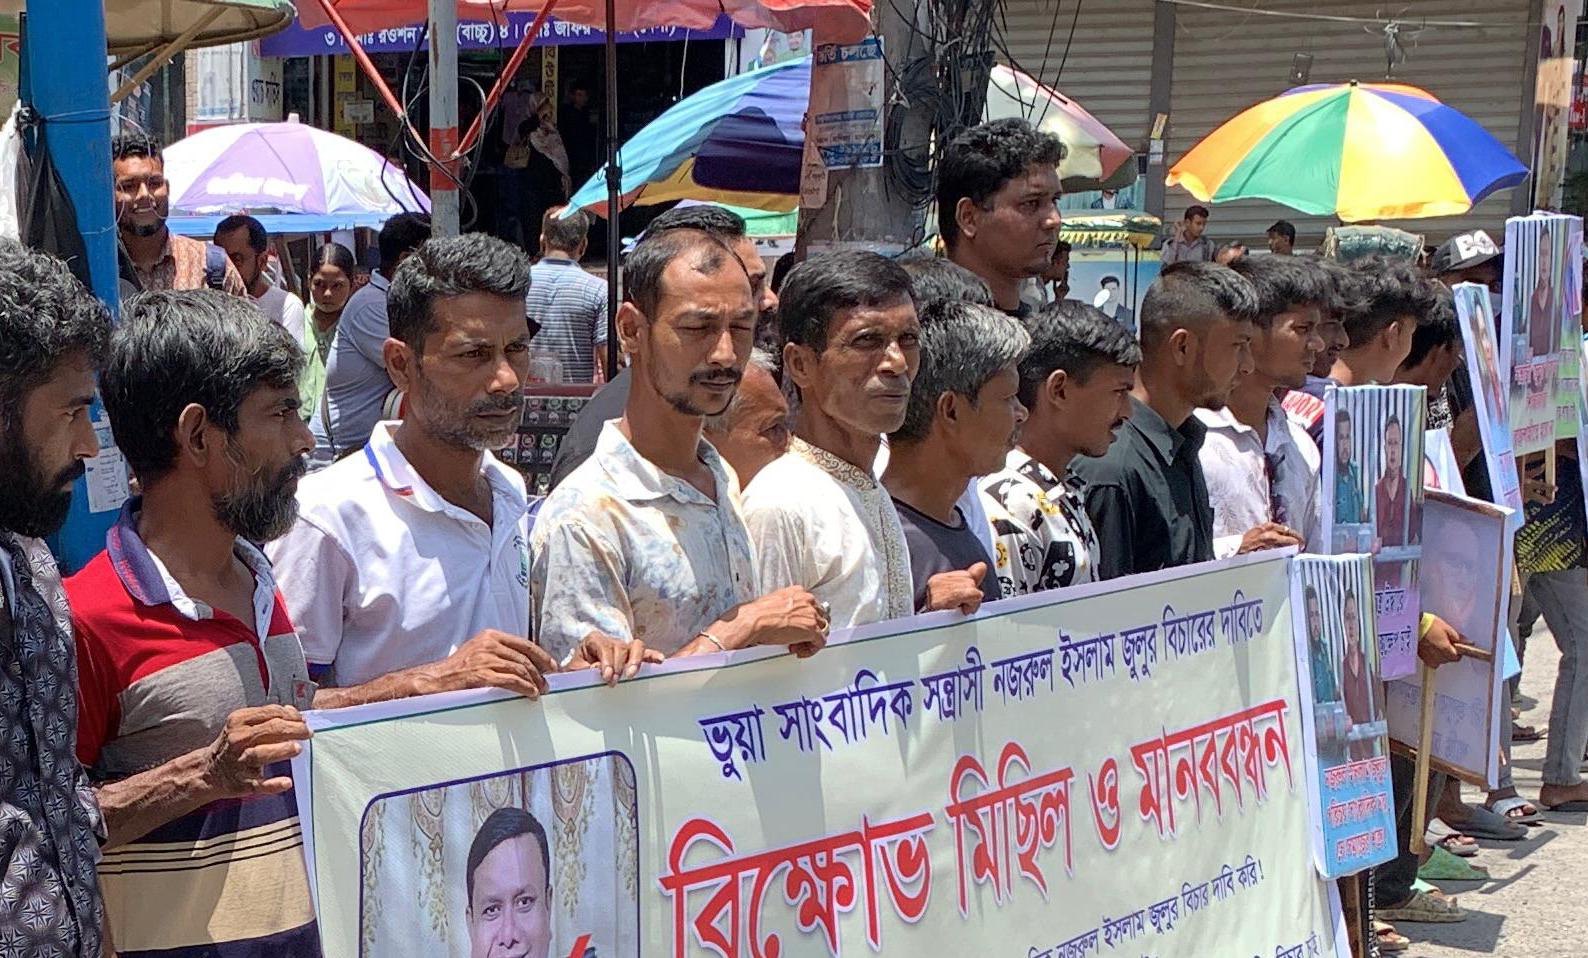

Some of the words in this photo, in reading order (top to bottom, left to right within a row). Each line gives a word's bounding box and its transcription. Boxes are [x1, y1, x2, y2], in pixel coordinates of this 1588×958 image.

[701, 710, 766, 781] ভুয়া
[775, 670, 913, 751] সাংবাদিক
[923, 648, 985, 722] সন্ত্রাসী
[993, 647, 1055, 704] নজরুল
[1059, 634, 1115, 690] ইসলাম
[1121, 625, 1157, 682] জুলুর
[1163, 607, 1215, 658] বিচারের
[1220, 598, 1264, 647] দাবিতে
[950, 742, 1074, 915] মিছিল
[1092, 758, 1120, 850] ও
[1131, 699, 1292, 838] মানববন্ধন
[1102, 910, 1145, 949] ইসলাম
[1148, 896, 1179, 935] জুলুর
[1182, 882, 1210, 916] বিচার
[1212, 864, 1235, 901] দাবি
